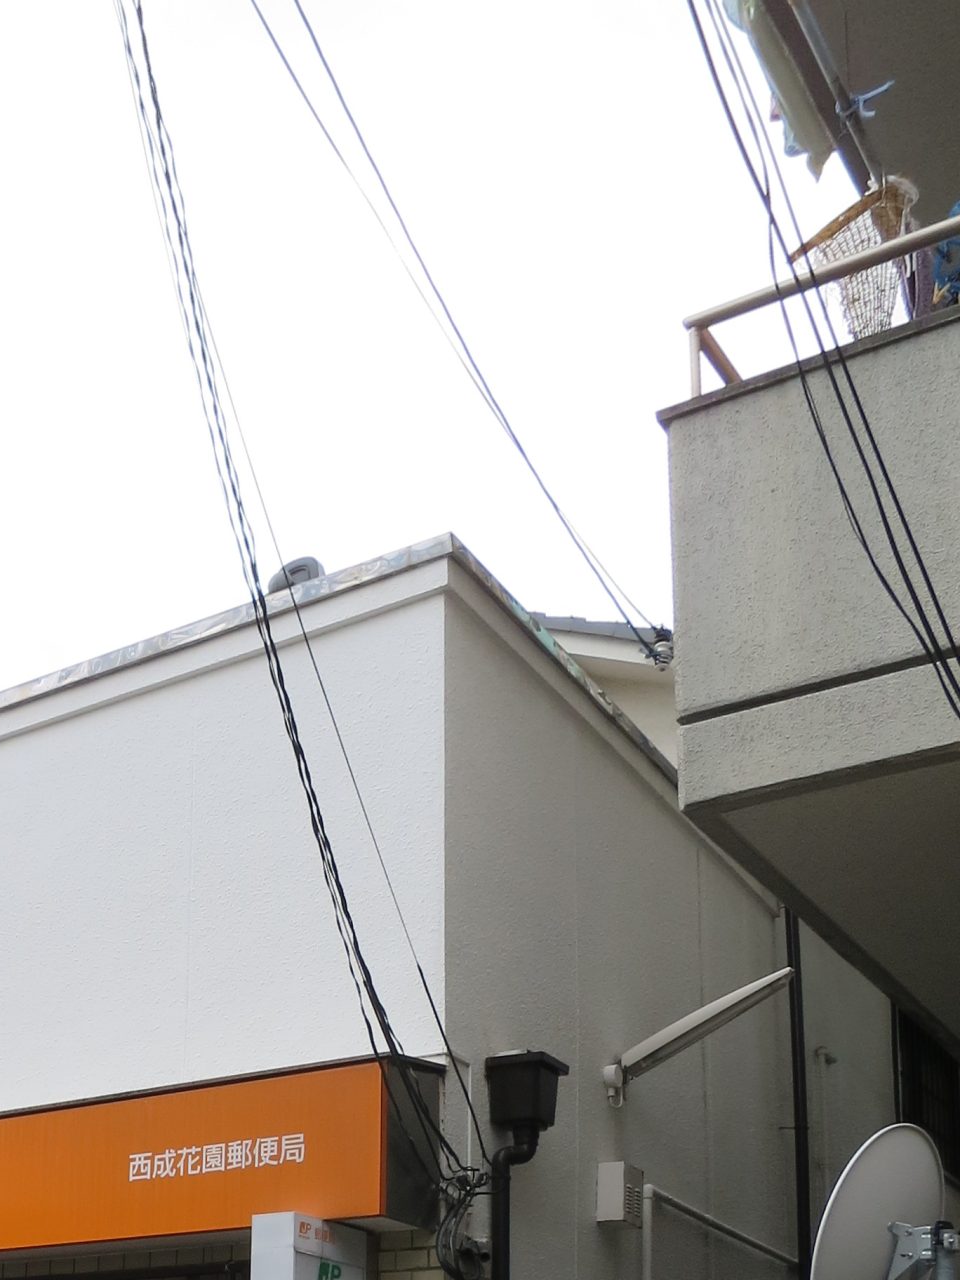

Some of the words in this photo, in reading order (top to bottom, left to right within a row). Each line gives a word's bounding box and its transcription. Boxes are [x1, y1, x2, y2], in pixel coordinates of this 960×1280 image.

[128, 1133, 305, 1182] 西成花園郵便局
